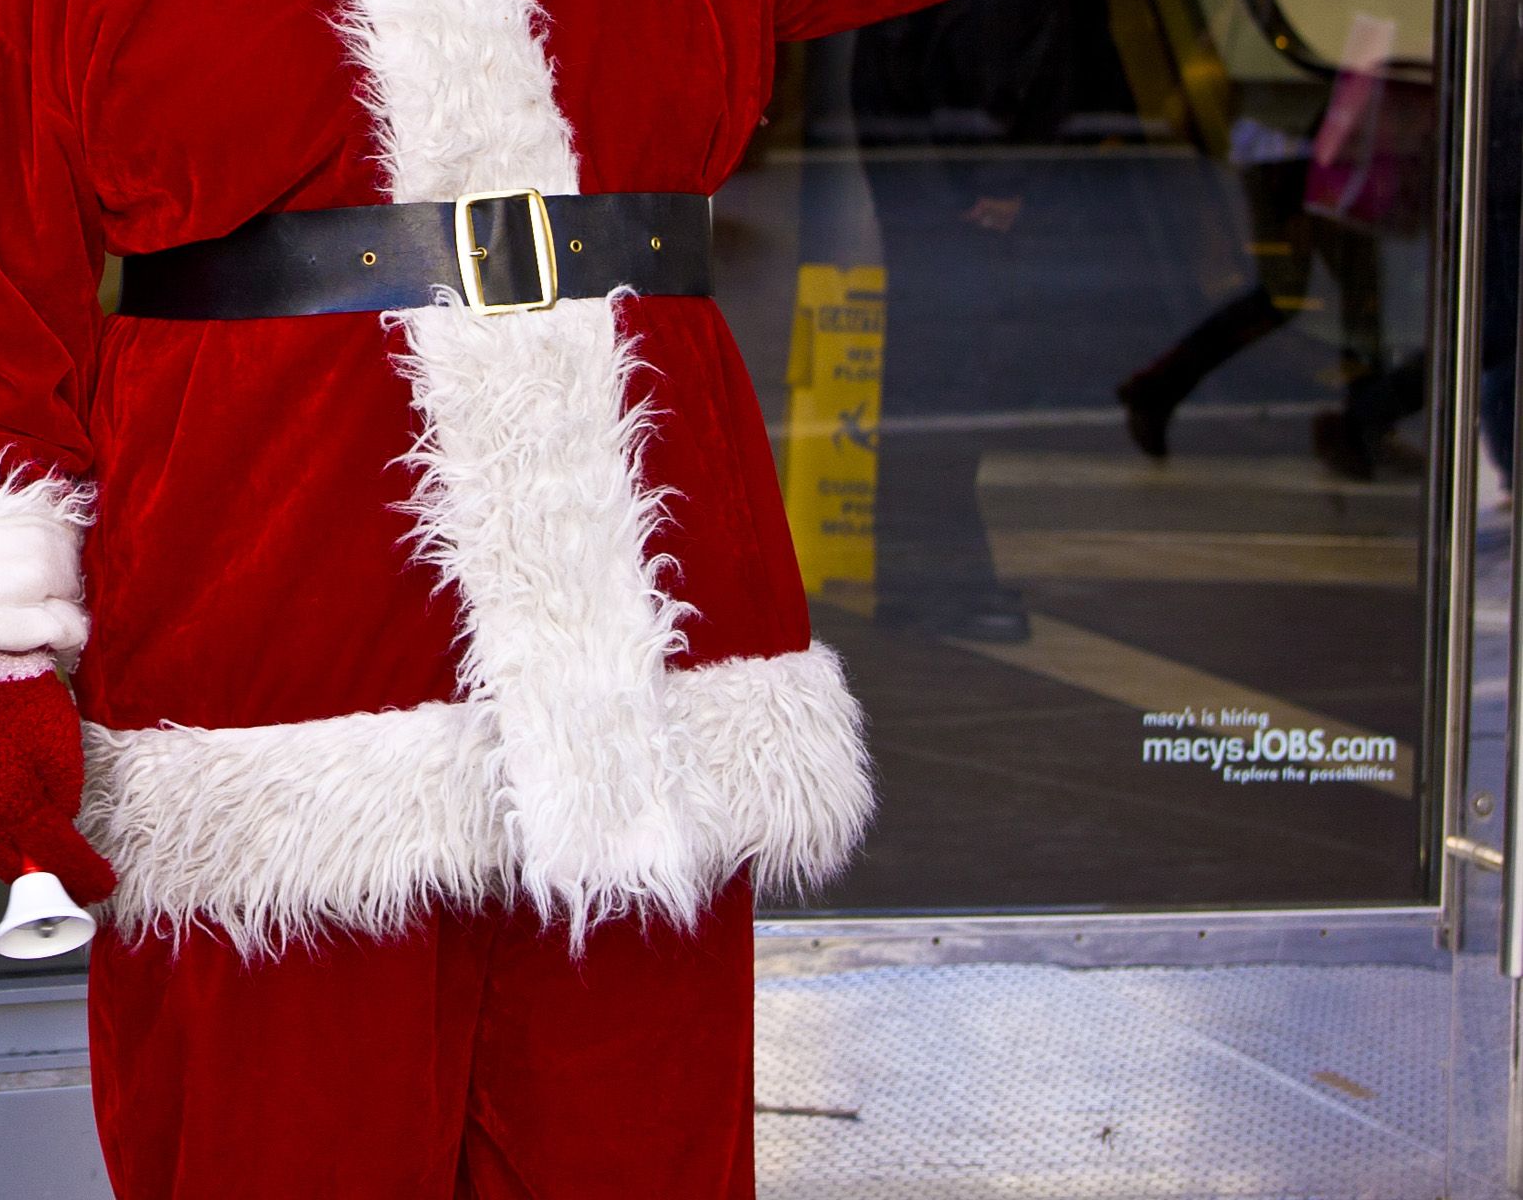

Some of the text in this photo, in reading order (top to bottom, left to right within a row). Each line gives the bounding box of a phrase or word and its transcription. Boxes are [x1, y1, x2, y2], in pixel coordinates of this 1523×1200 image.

[1143, 706, 1270, 730] macy's is hiring
[1143, 729, 1396, 770] macysJOBS.com
[1223, 765, 1395, 784] Explore the possibilities
